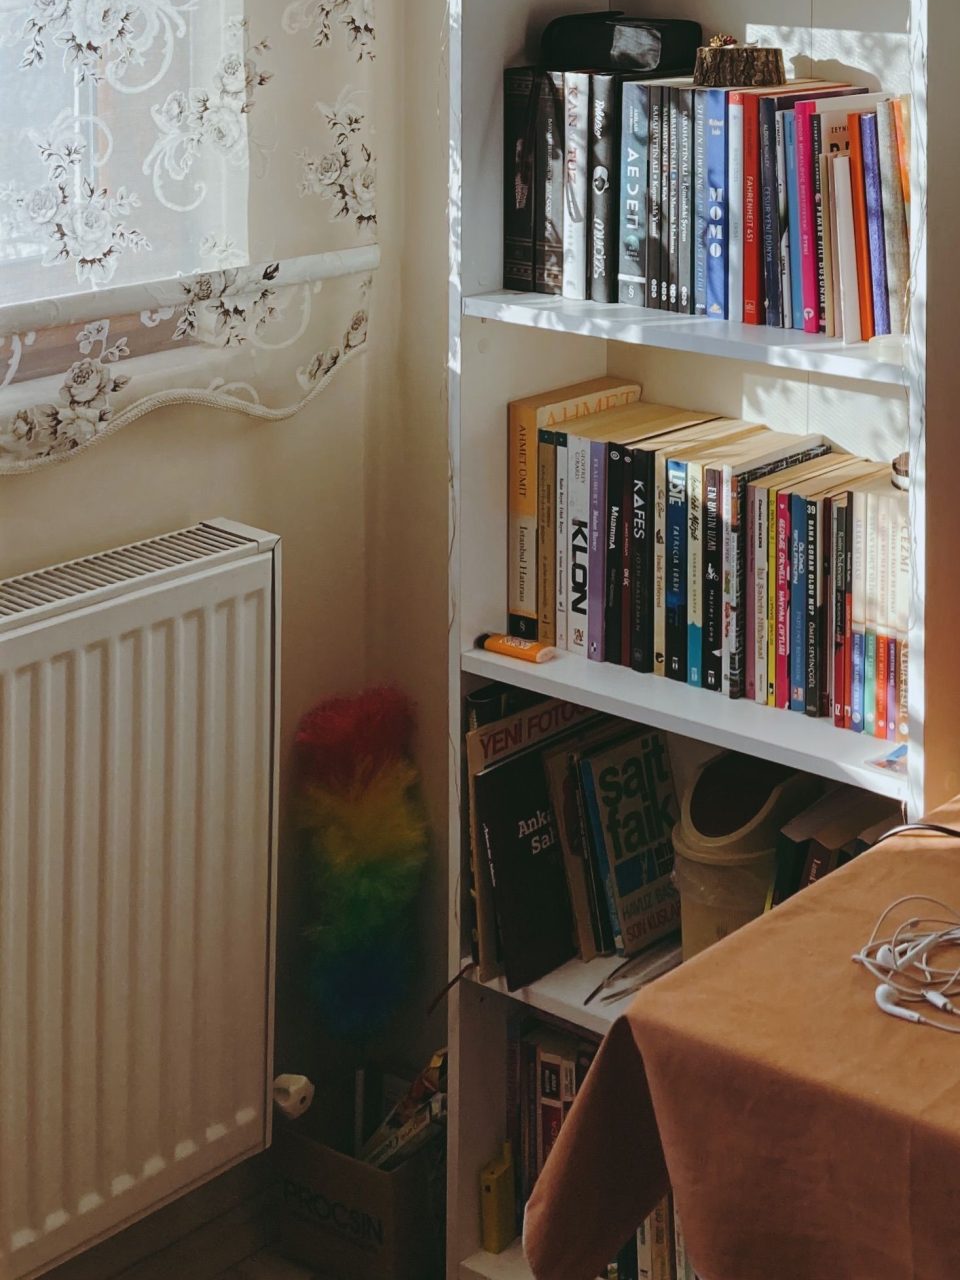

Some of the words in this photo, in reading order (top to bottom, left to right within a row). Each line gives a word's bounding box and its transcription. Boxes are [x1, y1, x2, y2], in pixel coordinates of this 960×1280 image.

[568, 85, 580, 128] KAN
[696, 104, 705, 145] STEPHEN
[762, 123, 771, 146] ALDOUS
[566, 146, 579, 186] TUZ
[696, 146, 705, 191] HAWKING
[745, 175, 754, 228] FAHRENHEIT
[708, 187, 725, 259] MOMO
[745, 228, 754, 243] 451
[766, 234, 775, 263] DÜNYA
[518, 423, 529, 466] AHMET
[518, 468, 530, 498] ÜMİT
[668, 470, 686, 506] LİSTE
[608, 505, 620, 550] MuammA
[633, 479, 646, 540] KAFES
[806, 504, 816, 515] 39
[518, 525, 530, 564] İstanbul
[777, 517, 786, 549] GEORGE
[807, 519, 816, 543] DAHA
[571, 518, 588, 616] KLON
[777, 550, 786, 586] ORWELL
[807, 544, 816, 571] SORAN
[518, 565, 529, 603] Hatırası
[807, 573, 816, 596] OLDU
[777, 589, 786, 623] HAYVAN
[807, 597, 816, 617] MU?
[807, 621, 817, 646] ÖMER
[807, 646, 817, 689] SEVİNÇGÜL
[479, 718, 524, 759] YENİ
[599, 733, 671, 808] sait
[606, 791, 676, 861] faik
